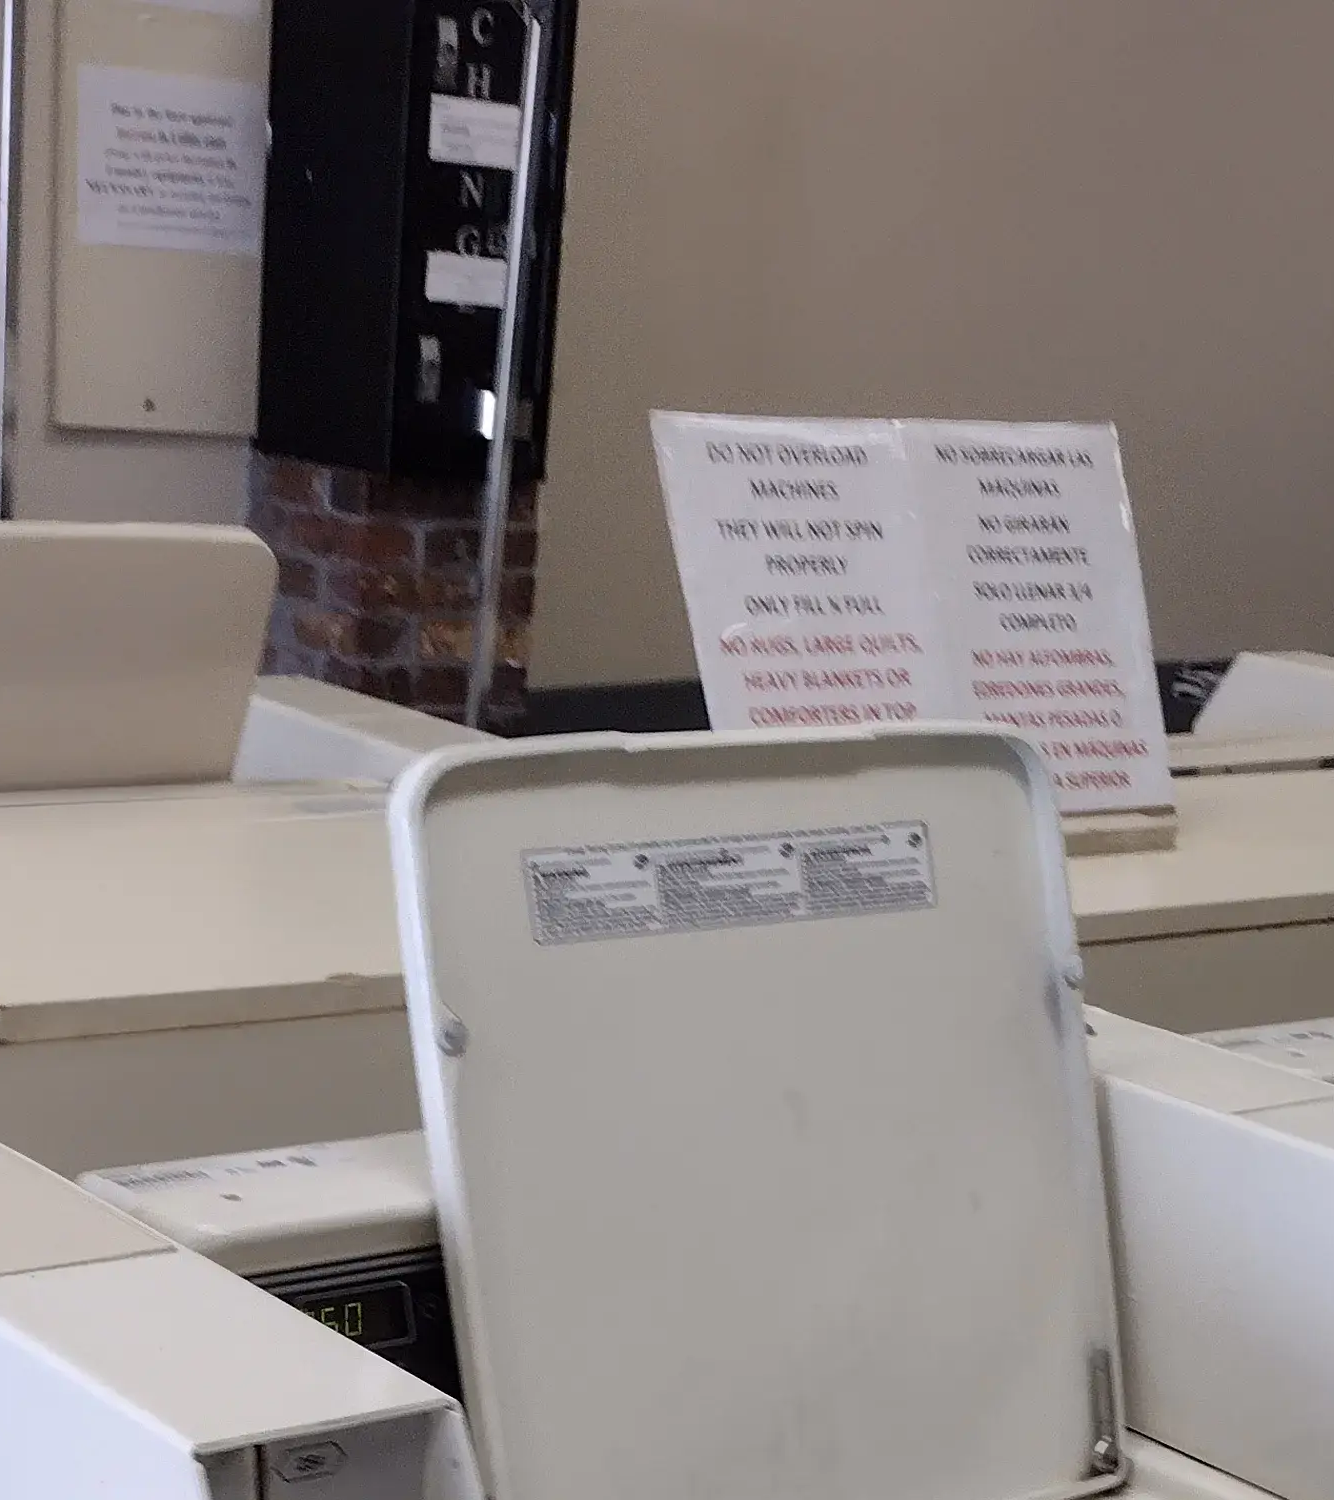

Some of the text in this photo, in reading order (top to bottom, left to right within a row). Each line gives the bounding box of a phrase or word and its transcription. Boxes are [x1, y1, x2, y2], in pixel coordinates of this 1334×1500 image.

[707, 442, 869, 467] DO NOT OVERLOAD
[748, 478, 840, 501] MACHINES
[715, 518, 884, 541] THEY WILL NOT SPIN
[764, 554, 848, 577] PROPERLY
[743, 594, 790, 617] ONLY
[791, 594, 825, 616] FILL
[843, 595, 885, 617] FULL
[998, 611, 1078, 633] COMPLETO
[719, 634, 747, 656] NO
[802, 633, 854, 655] LARGE
[742, 669, 799, 693] HEAVY
[801, 667, 885, 691] BLANKETS
